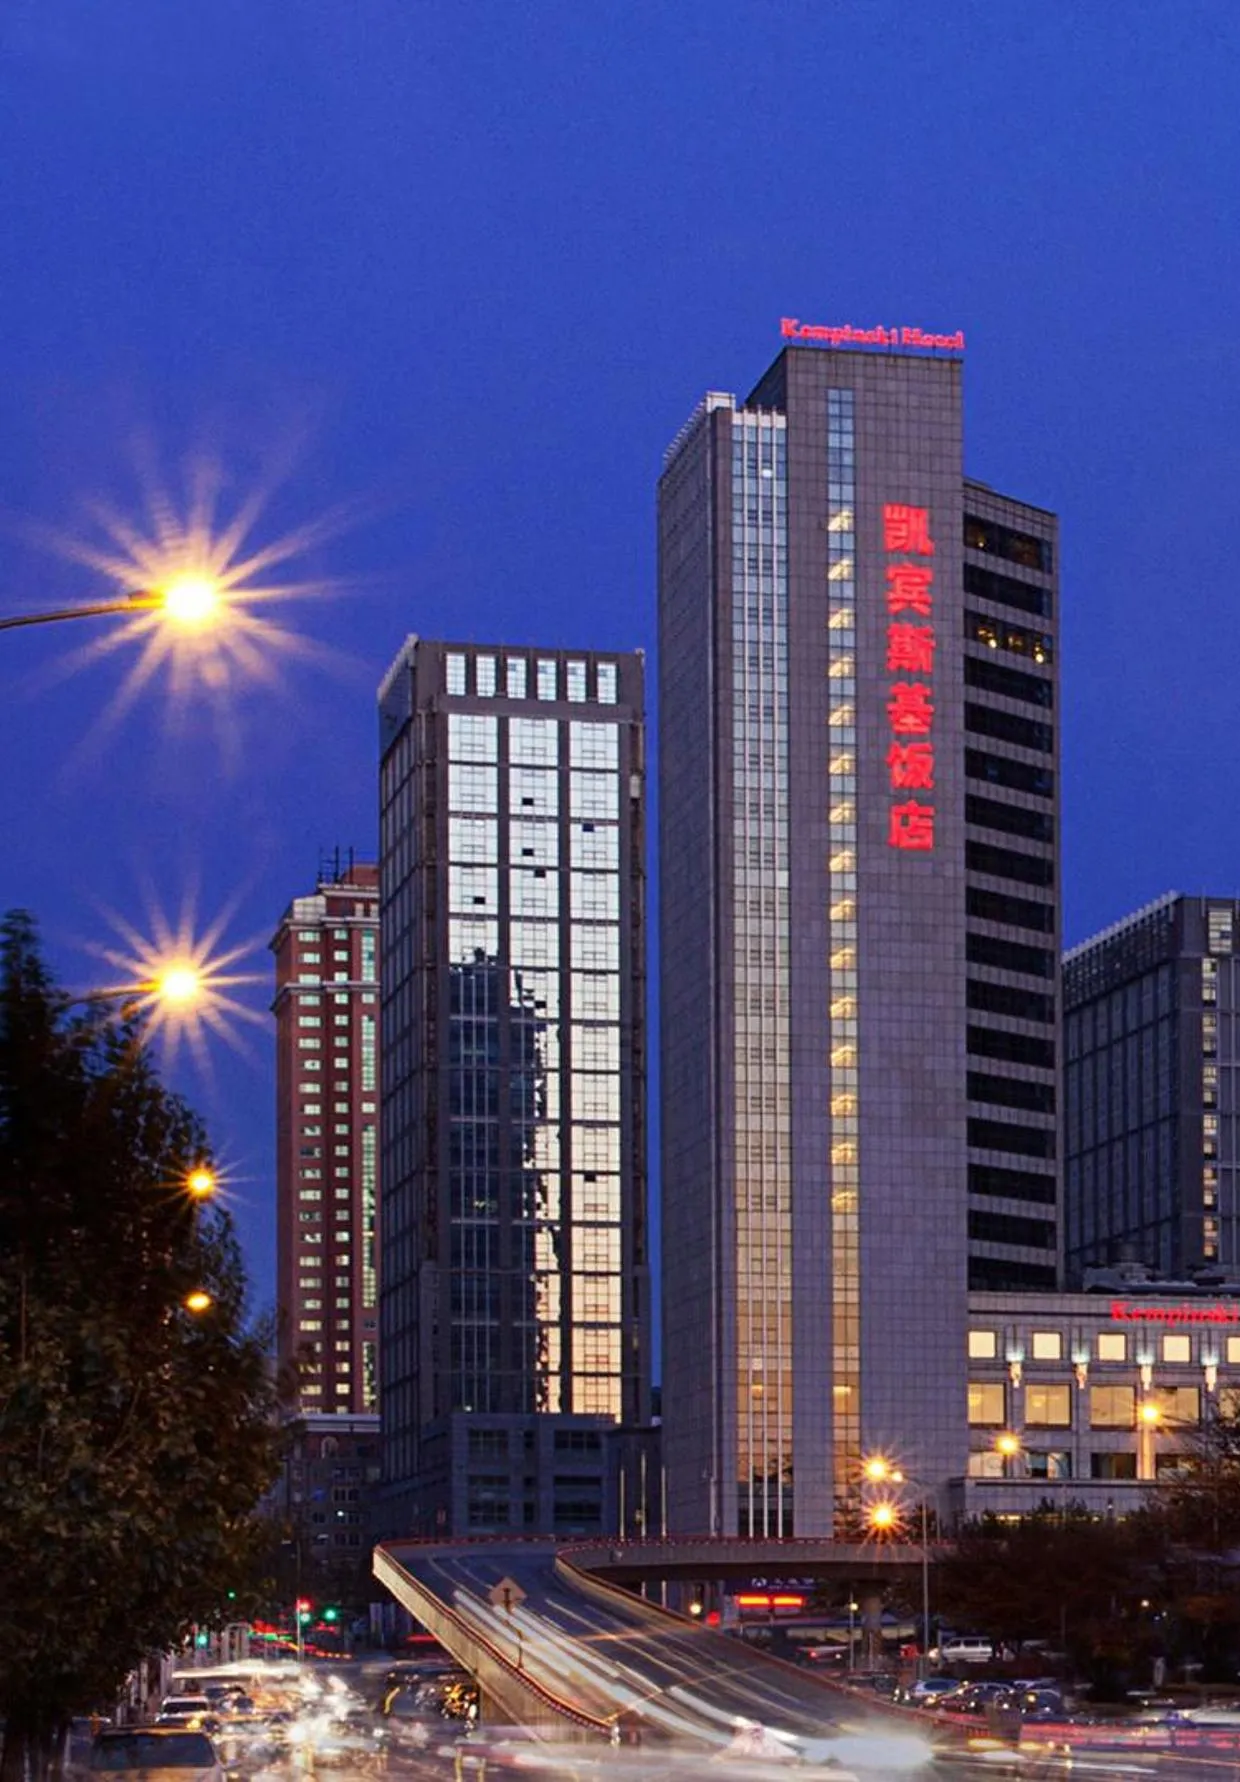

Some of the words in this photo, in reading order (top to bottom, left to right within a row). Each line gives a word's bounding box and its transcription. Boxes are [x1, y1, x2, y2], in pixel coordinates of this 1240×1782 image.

[882, 503, 936, 851] 凯宾斯基饭店
